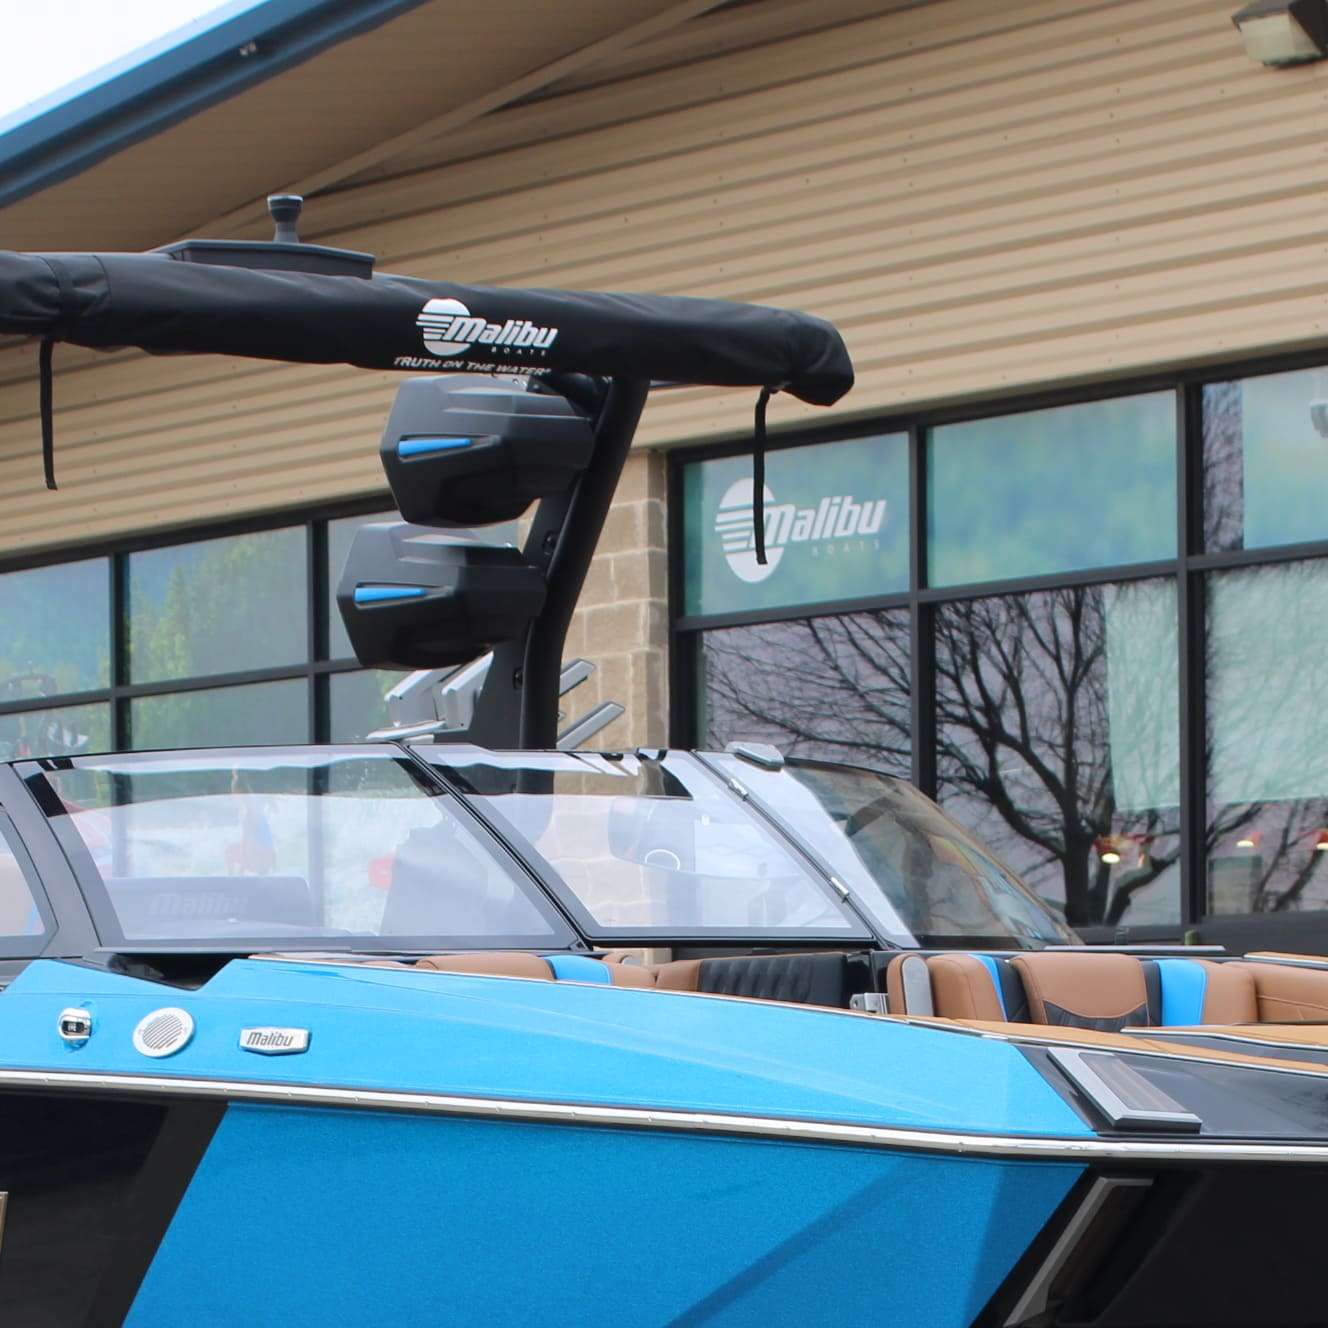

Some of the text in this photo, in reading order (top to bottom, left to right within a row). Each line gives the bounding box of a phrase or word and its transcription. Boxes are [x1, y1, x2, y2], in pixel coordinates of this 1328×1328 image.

[442, 317, 559, 348] Malibu
[393, 356, 440, 368] TRUTH
[442, 360, 465, 369] ON
[466, 361, 495, 371] THE
[748, 496, 887, 548] Malibu
[246, 1031, 295, 1047] Malibu
